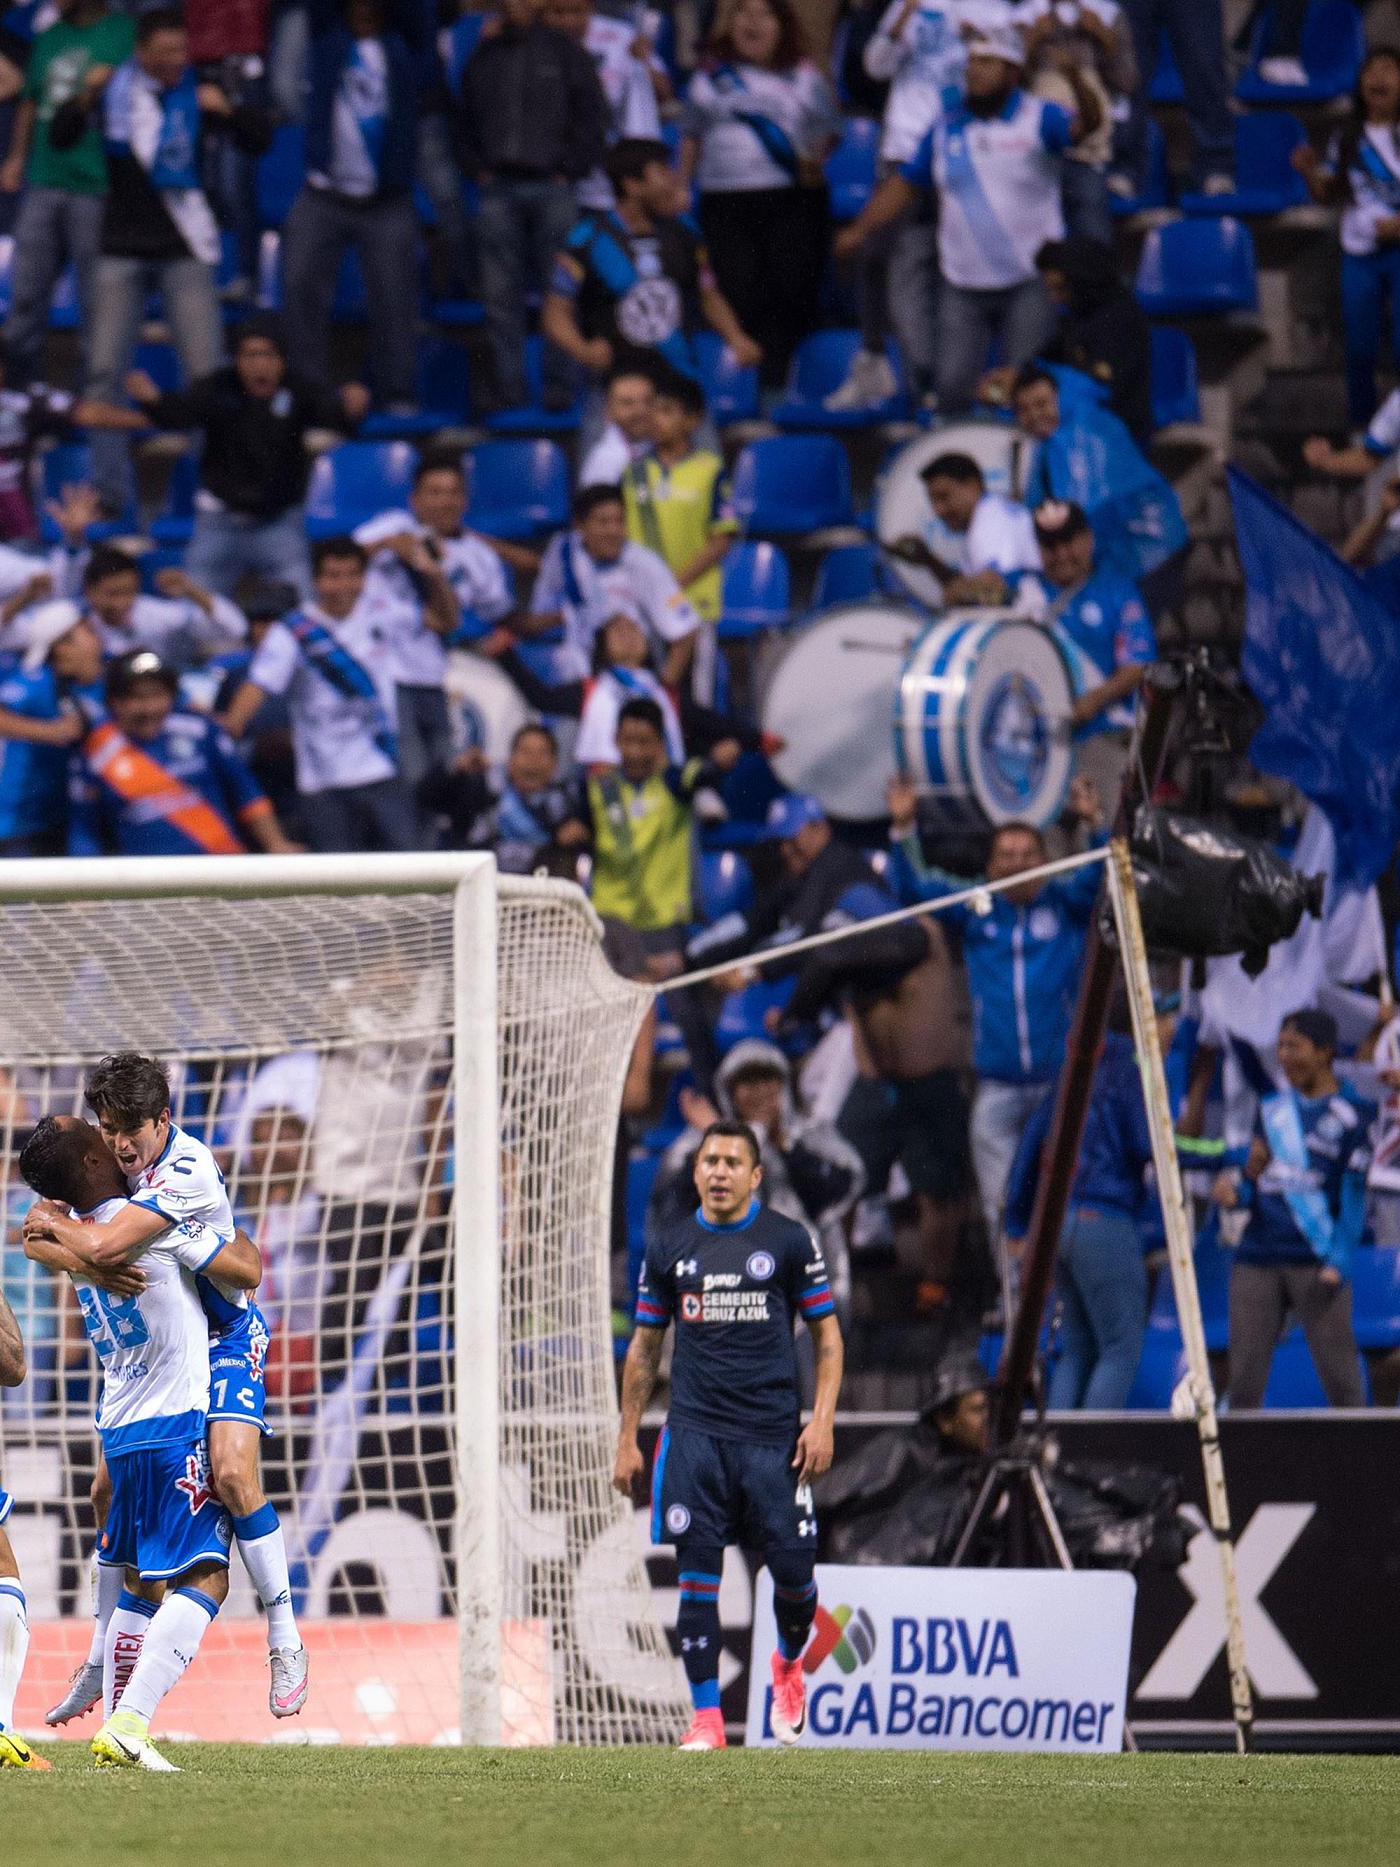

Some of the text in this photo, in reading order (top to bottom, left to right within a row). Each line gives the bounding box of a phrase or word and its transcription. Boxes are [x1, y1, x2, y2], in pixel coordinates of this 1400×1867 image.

[702, 1292, 768, 1307] CEMENTO
[703, 1307, 770, 1321] CRUZ AZUL
[891, 1616, 1020, 1678] BBVA
[885, 1683, 1114, 1745] Bancomer
